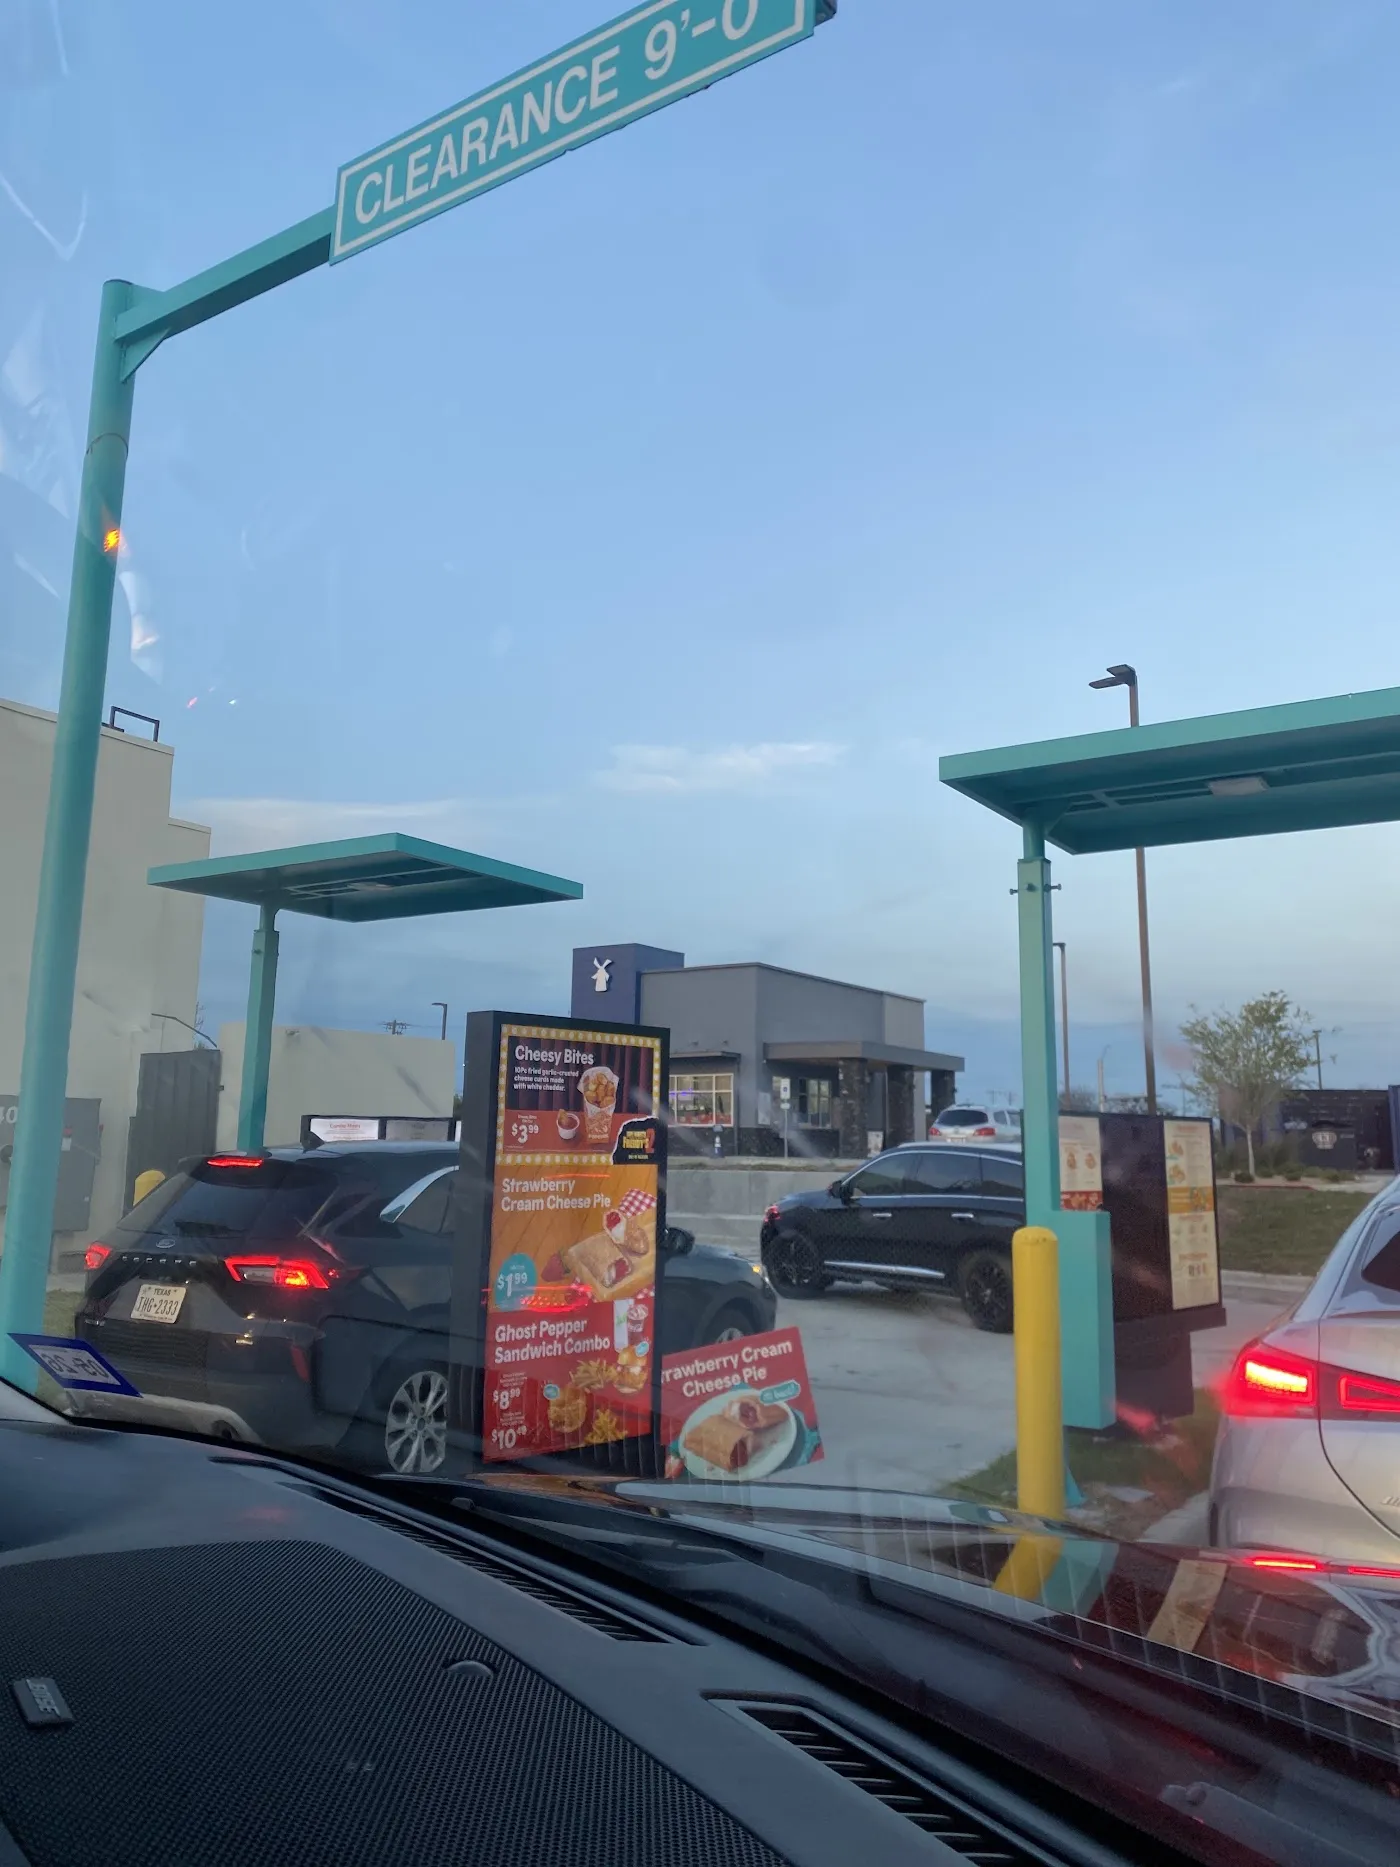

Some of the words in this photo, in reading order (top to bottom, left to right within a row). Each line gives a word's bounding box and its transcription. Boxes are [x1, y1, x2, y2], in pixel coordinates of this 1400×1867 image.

[354, 45, 621, 225] CLEARANCE
[515, 1045, 562, 1065] Cheesy
[563, 1048, 594, 1065] Bites
[513, 1082, 526, 1090] with
[514, 1074, 533, 1082] cheese
[502, 1177, 576, 1195] Strawberry
[501, 1197, 544, 1212] Cream
[546, 1195, 590, 1210] Cheese
[592, 1193, 611, 1208] Pie
[153, 1288, 172, 1296] TEXAS
[495, 1322, 537, 1343] Ghost
[539, 1319, 588, 1340] Pepper
[494, 1340, 562, 1364] Sandwich
[564, 1335, 611, 1355] Combo
[741, 1340, 793, 1363] Cream
[682, 1373, 741, 1398] Cheese
[743, 1366, 767, 1384] Pie
